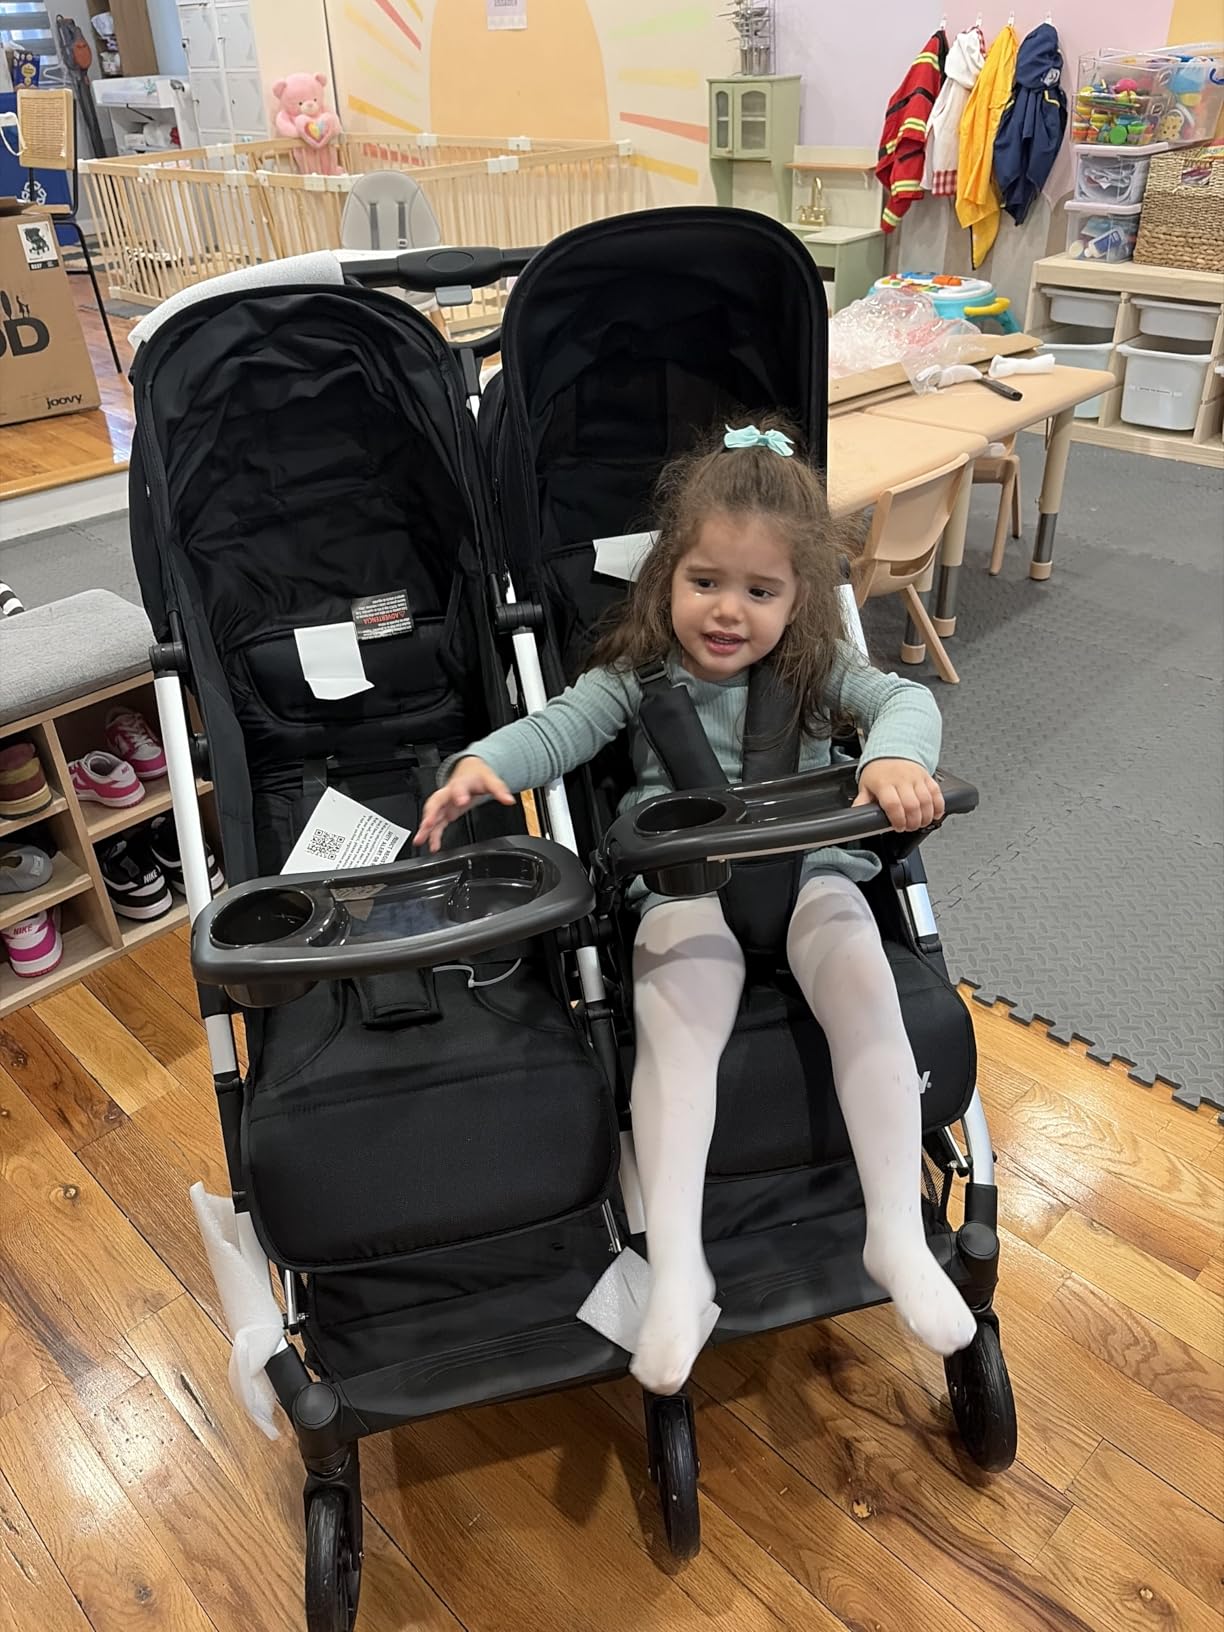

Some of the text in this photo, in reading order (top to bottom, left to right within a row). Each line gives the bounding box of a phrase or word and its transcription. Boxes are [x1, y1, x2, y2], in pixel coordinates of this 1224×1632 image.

[46, 394, 82, 410] joovy
[363, 612, 399, 624] ADVERTENCIA
[143, 869, 158, 884] NIKE
[13, 923, 33, 935] NIKE
